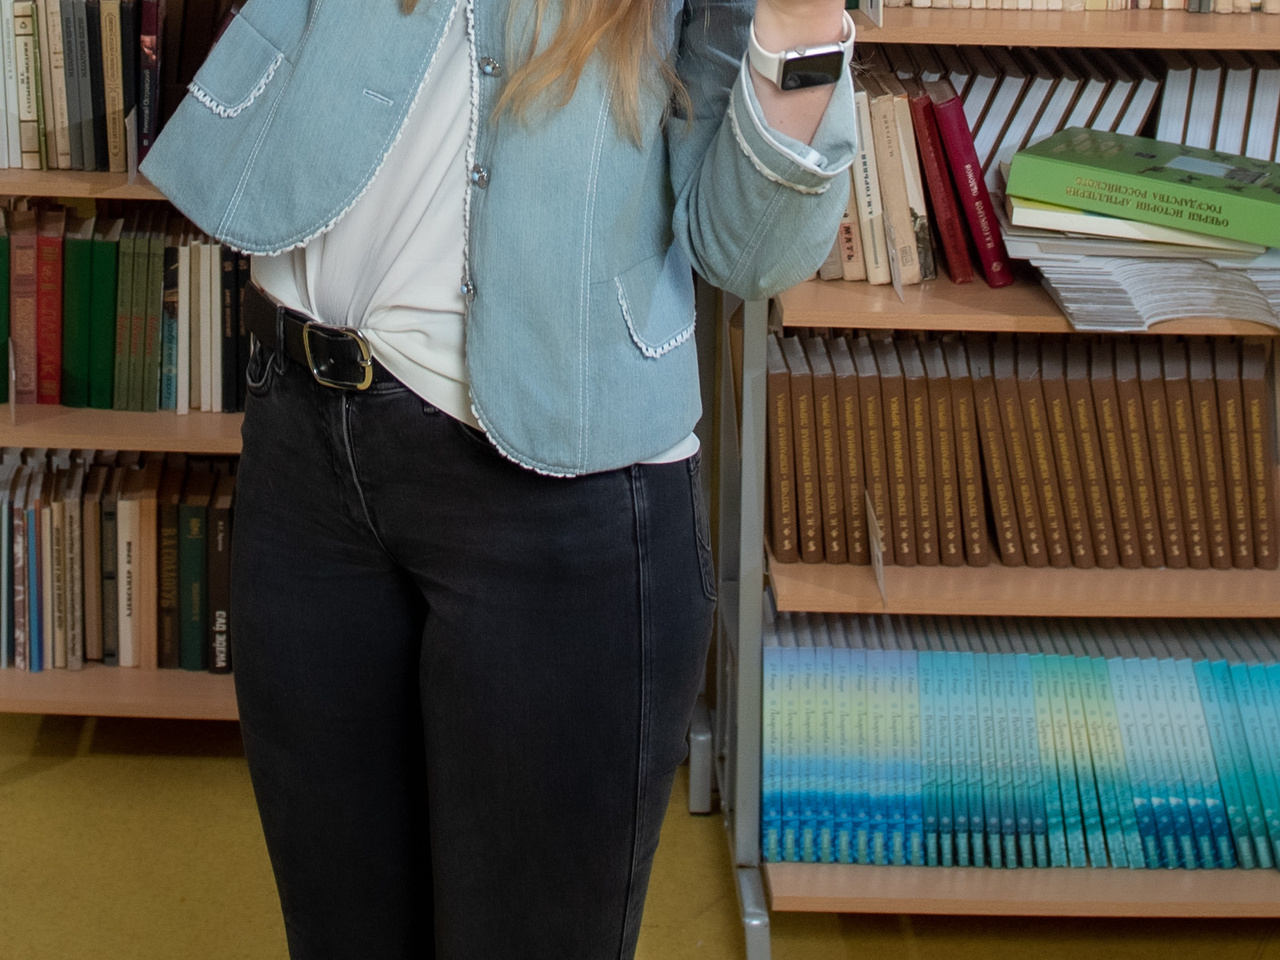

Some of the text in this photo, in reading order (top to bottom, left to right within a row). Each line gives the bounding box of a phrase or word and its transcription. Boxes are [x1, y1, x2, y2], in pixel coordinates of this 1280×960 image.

[965, 164, 979, 196] ОБЛОМОВ
[1075, 177, 1222, 214] ГОСУДАРСТВА РОССИЙСКОГО
[1065, 186, 1229, 228] ОЧЕРКИ ИСТОРИИ АРТИЛЛЕРИИ
[844, 225, 854, 261] МАТЬ
[212, 611, 227, 667] САД ЭДЕМА
